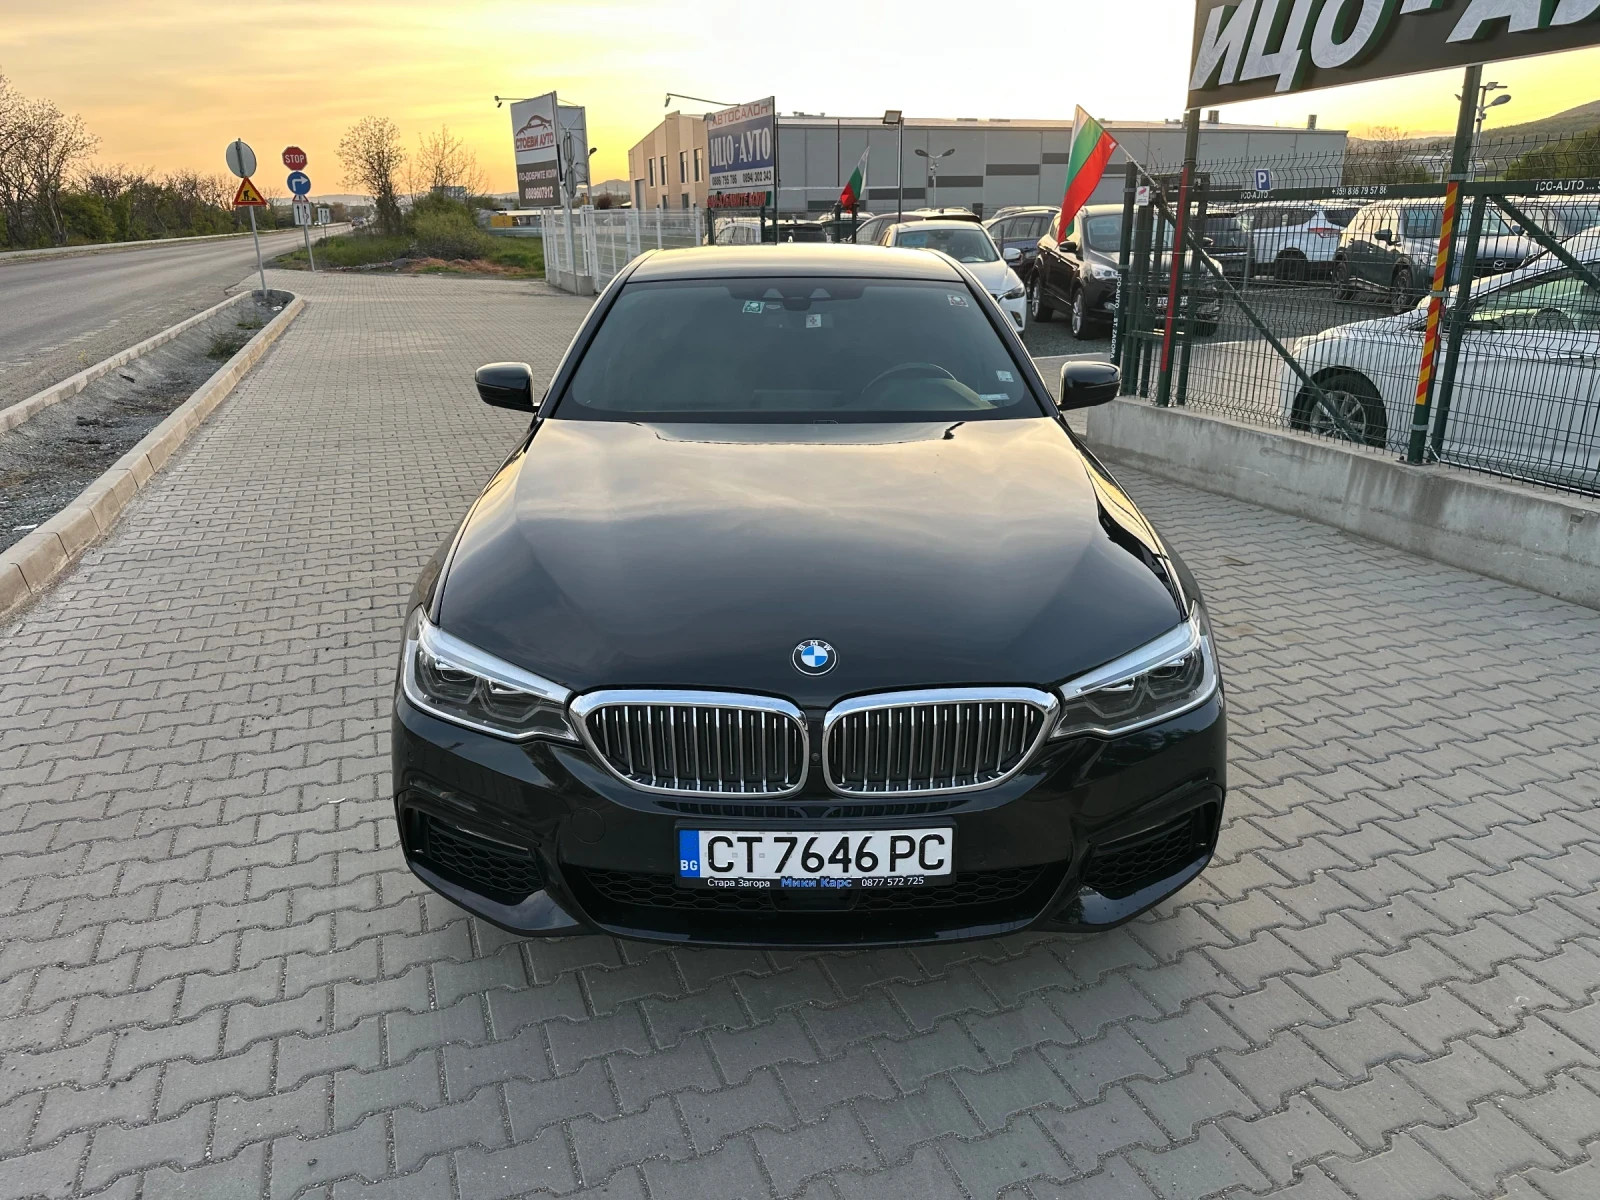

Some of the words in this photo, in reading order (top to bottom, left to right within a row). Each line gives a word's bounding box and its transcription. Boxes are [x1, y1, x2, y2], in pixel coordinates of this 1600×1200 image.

[516, 137, 539, 150] СТОЕВИ
[540, 133, 554, 146] АУТО
[284, 154, 305, 164] STOP
[1257, 171, 1267, 189] P
[773, 836, 879, 873] 7646
[680, 860, 698, 871] BG
[707, 878, 736, 888] Стара
[737, 878, 770, 888] Загора
[780, 877, 817, 888] Мики
[820, 877, 852, 889] Карс
[861, 878, 885, 887] 0877
[887, 877, 904, 886] 572
[907, 876, 924, 886] 725
